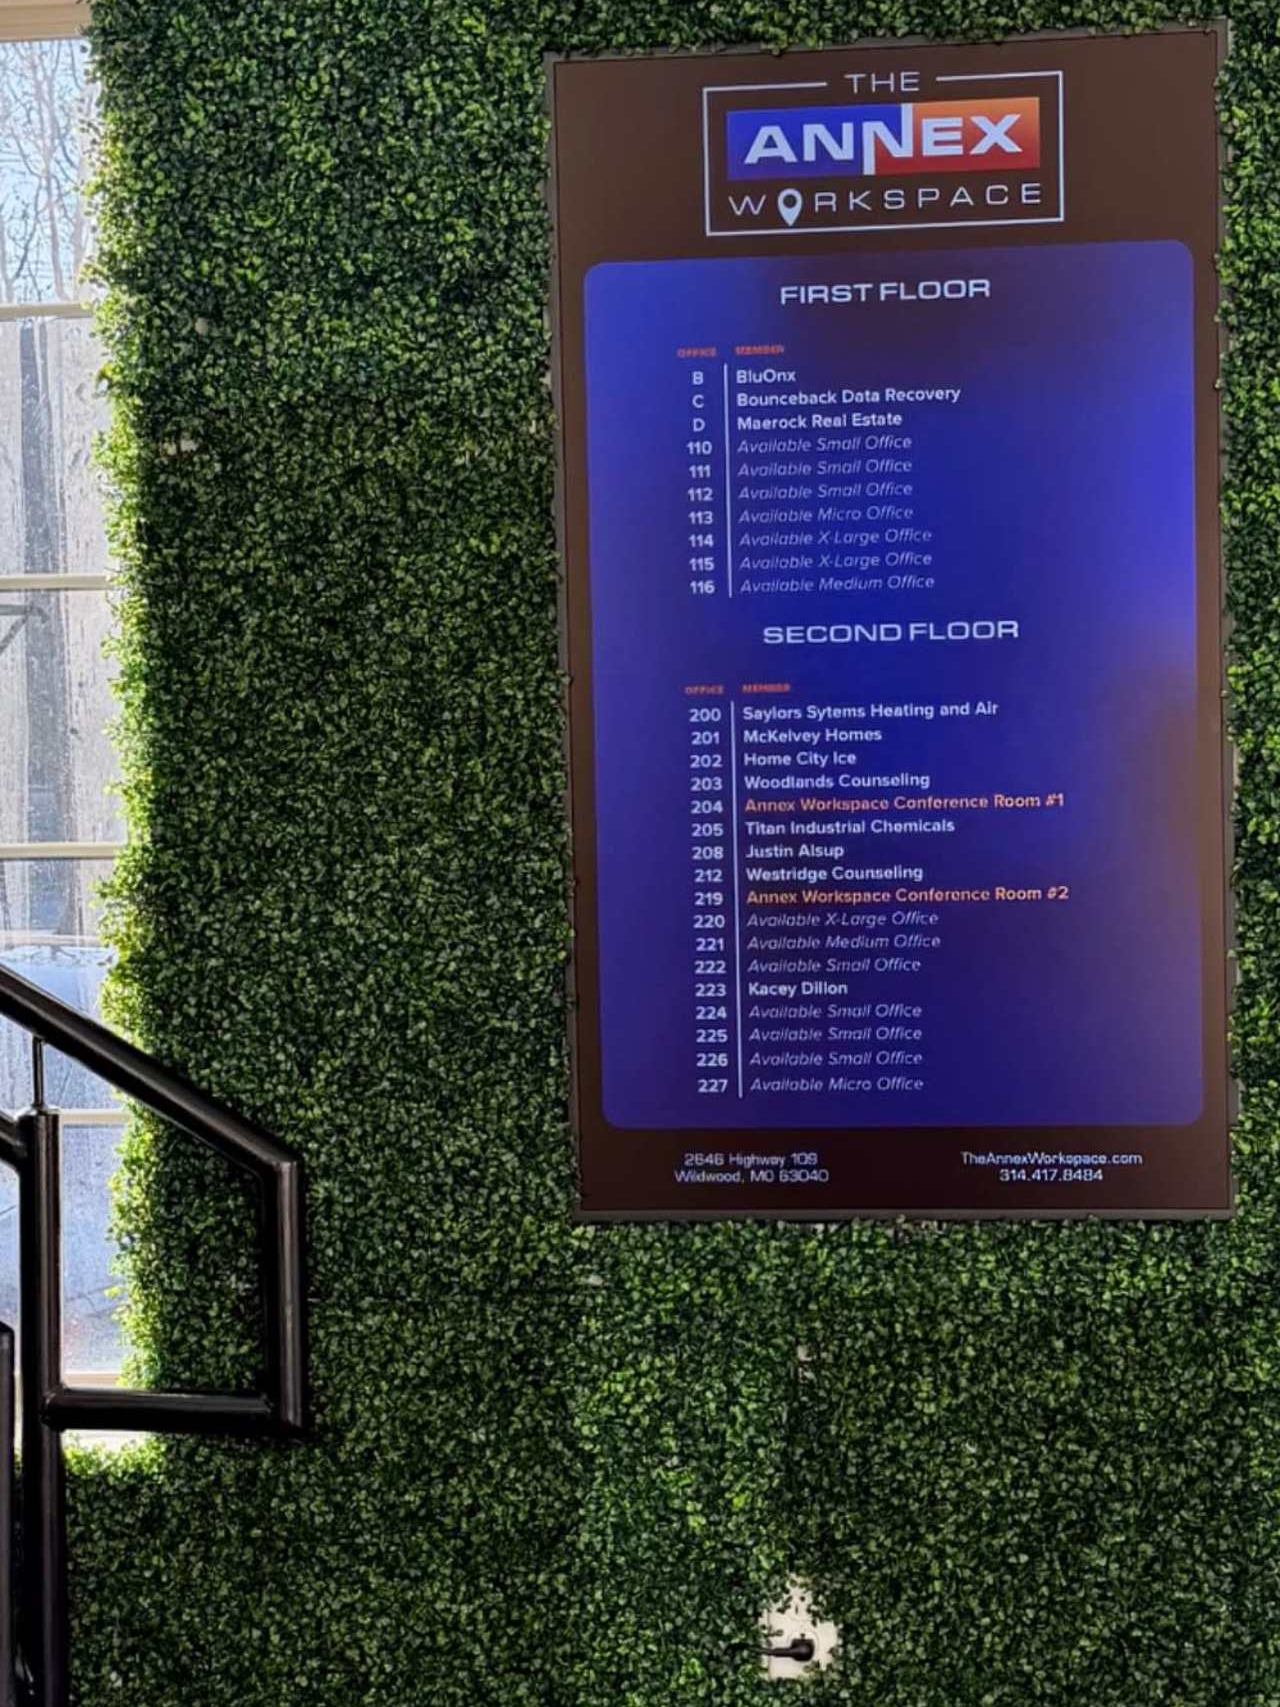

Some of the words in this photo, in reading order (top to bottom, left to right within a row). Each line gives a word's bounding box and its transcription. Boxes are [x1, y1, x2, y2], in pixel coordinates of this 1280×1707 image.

[845, 72, 920, 93] THE
[743, 104, 1022, 175] ANNEX
[781, 283, 873, 304] FIRST
[880, 279, 991, 301] FLOOR
[692, 371, 703, 385] B
[736, 369, 796, 384] BluOnx
[692, 395, 704, 408] C
[737, 392, 837, 407] Bounceback
[842, 389, 880, 403] Data
[885, 388, 961, 404] Recovery
[693, 418, 705, 431] D
[737, 415, 806, 430] Maerock
[812, 414, 846, 428] Real
[851, 413, 903, 427] Estate
[687, 442, 712, 455] 110
[737, 439, 812, 453] Available
[817, 436, 860, 451] Small
[865, 435, 912, 449] Office
[689, 465, 710, 478] 111
[737, 462, 812, 477] Available
[817, 460, 860, 474] Small
[865, 458, 912, 472] Office
[687, 488, 713, 502] 112
[738, 485, 812, 500] Available
[817, 483, 860, 498] Small
[866, 482, 913, 496] Office
[688, 511, 713, 525] 113
[738, 509, 812, 524] Available
[817, 506, 862, 521] Micro
[866, 505, 913, 520] Office
[688, 535, 714, 548] 114
[740, 532, 813, 547] Available
[885, 529, 932, 542] Office
[689, 558, 714, 571] 115
[740, 555, 813, 570] Available
[818, 553, 880, 570] X-Large
[885, 552, 932, 566] Office
[690, 581, 715, 595] 116
[740, 578, 814, 593] Available
[819, 577, 882, 591] Medium
[887, 575, 934, 589] Office
[763, 624, 901, 643] SECOND
[909, 621, 1019, 641] FLOOR
[689, 709, 721, 722] 200
[743, 706, 802, 723] Saylors
[806, 705, 866, 722] Sytems
[870, 703, 934, 720] Heating
[940, 703, 970, 716] and
[975, 702, 999, 715] Air
[691, 731, 721, 745] 201
[744, 728, 821, 746] McKelvey
[825, 727, 882, 742] Homes
[690, 754, 722, 768] 202
[744, 753, 791, 766] Home
[796, 751, 828, 768] City
[833, 751, 856, 764] Ice
[690, 777, 722, 791] 203
[745, 774, 834, 790] Woodlands
[838, 772, 931, 790] Counseling
[690, 800, 723, 814] 204
[745, 798, 795, 812] Annex
[800, 797, 889, 814] Workspace
[894, 794, 988, 810] Conference
[994, 794, 1041, 808] Room
[1046, 793, 1064, 807] #1
[691, 823, 723, 837] 205
[745, 821, 786, 835] Titan
[790, 820, 866, 834] Industrial
[870, 818, 955, 833] Chemicals
[692, 845, 724, 860] 208
[745, 845, 793, 859] Justin
[798, 844, 844, 860] Alsup
[694, 868, 723, 883] 212
[746, 867, 828, 884] Westridge
[832, 865, 923, 883] Counseling
[694, 891, 723, 906] 219
[747, 890, 798, 905] Annex
[802, 888, 891, 907] Workspace
[895, 887, 990, 902] Conference
[995, 888, 1042, 901] Room
[1047, 886, 1068, 900] #2
[693, 914, 725, 929] 220
[747, 912, 821, 928] Available
[825, 911, 887, 928] X-Large
[892, 910, 939, 925] Office
[695, 937, 725, 952] 221
[747, 935, 822, 950] Available
[825, 934, 889, 949] Medium
[894, 933, 941, 948] Office
[694, 960, 726, 975] 222
[747, 958, 822, 973] Available
[826, 957, 870, 972] Small
[874, 957, 921, 972] Office
[695, 983, 727, 997] 223
[748, 982, 797, 998] Kacey
[801, 981, 848, 996] Dillon
[695, 1006, 727, 1020] 224
[749, 1004, 822, 1019] Available
[827, 1003, 870, 1018] Small
[875, 1003, 922, 1018] Office
[696, 1029, 728, 1043] 225
[749, 1027, 822, 1042] Available
[827, 1026, 871, 1041] Small
[876, 1026, 922, 1041] Office
[696, 1053, 728, 1068] 226
[749, 1051, 823, 1066] Available
[828, 1051, 871, 1066] Small
[876, 1050, 923, 1065] Office
[697, 1078, 728, 1094] 227
[750, 1077, 823, 1093] Available
[828, 1076, 872, 1092] Micro
[877, 1076, 924, 1091] Office
[729, 1153, 786, 1168] Highway
[791, 1152, 818, 1166] 109
[960, 1151, 1143, 1167] TheAnnexWorkspace.com
[674, 1169, 745, 1184] Wildwood,
[750, 1170, 774, 1182] MO
[779, 1169, 829, 1183] 63040
[999, 1168, 1103, 1182] 314.417.8484
